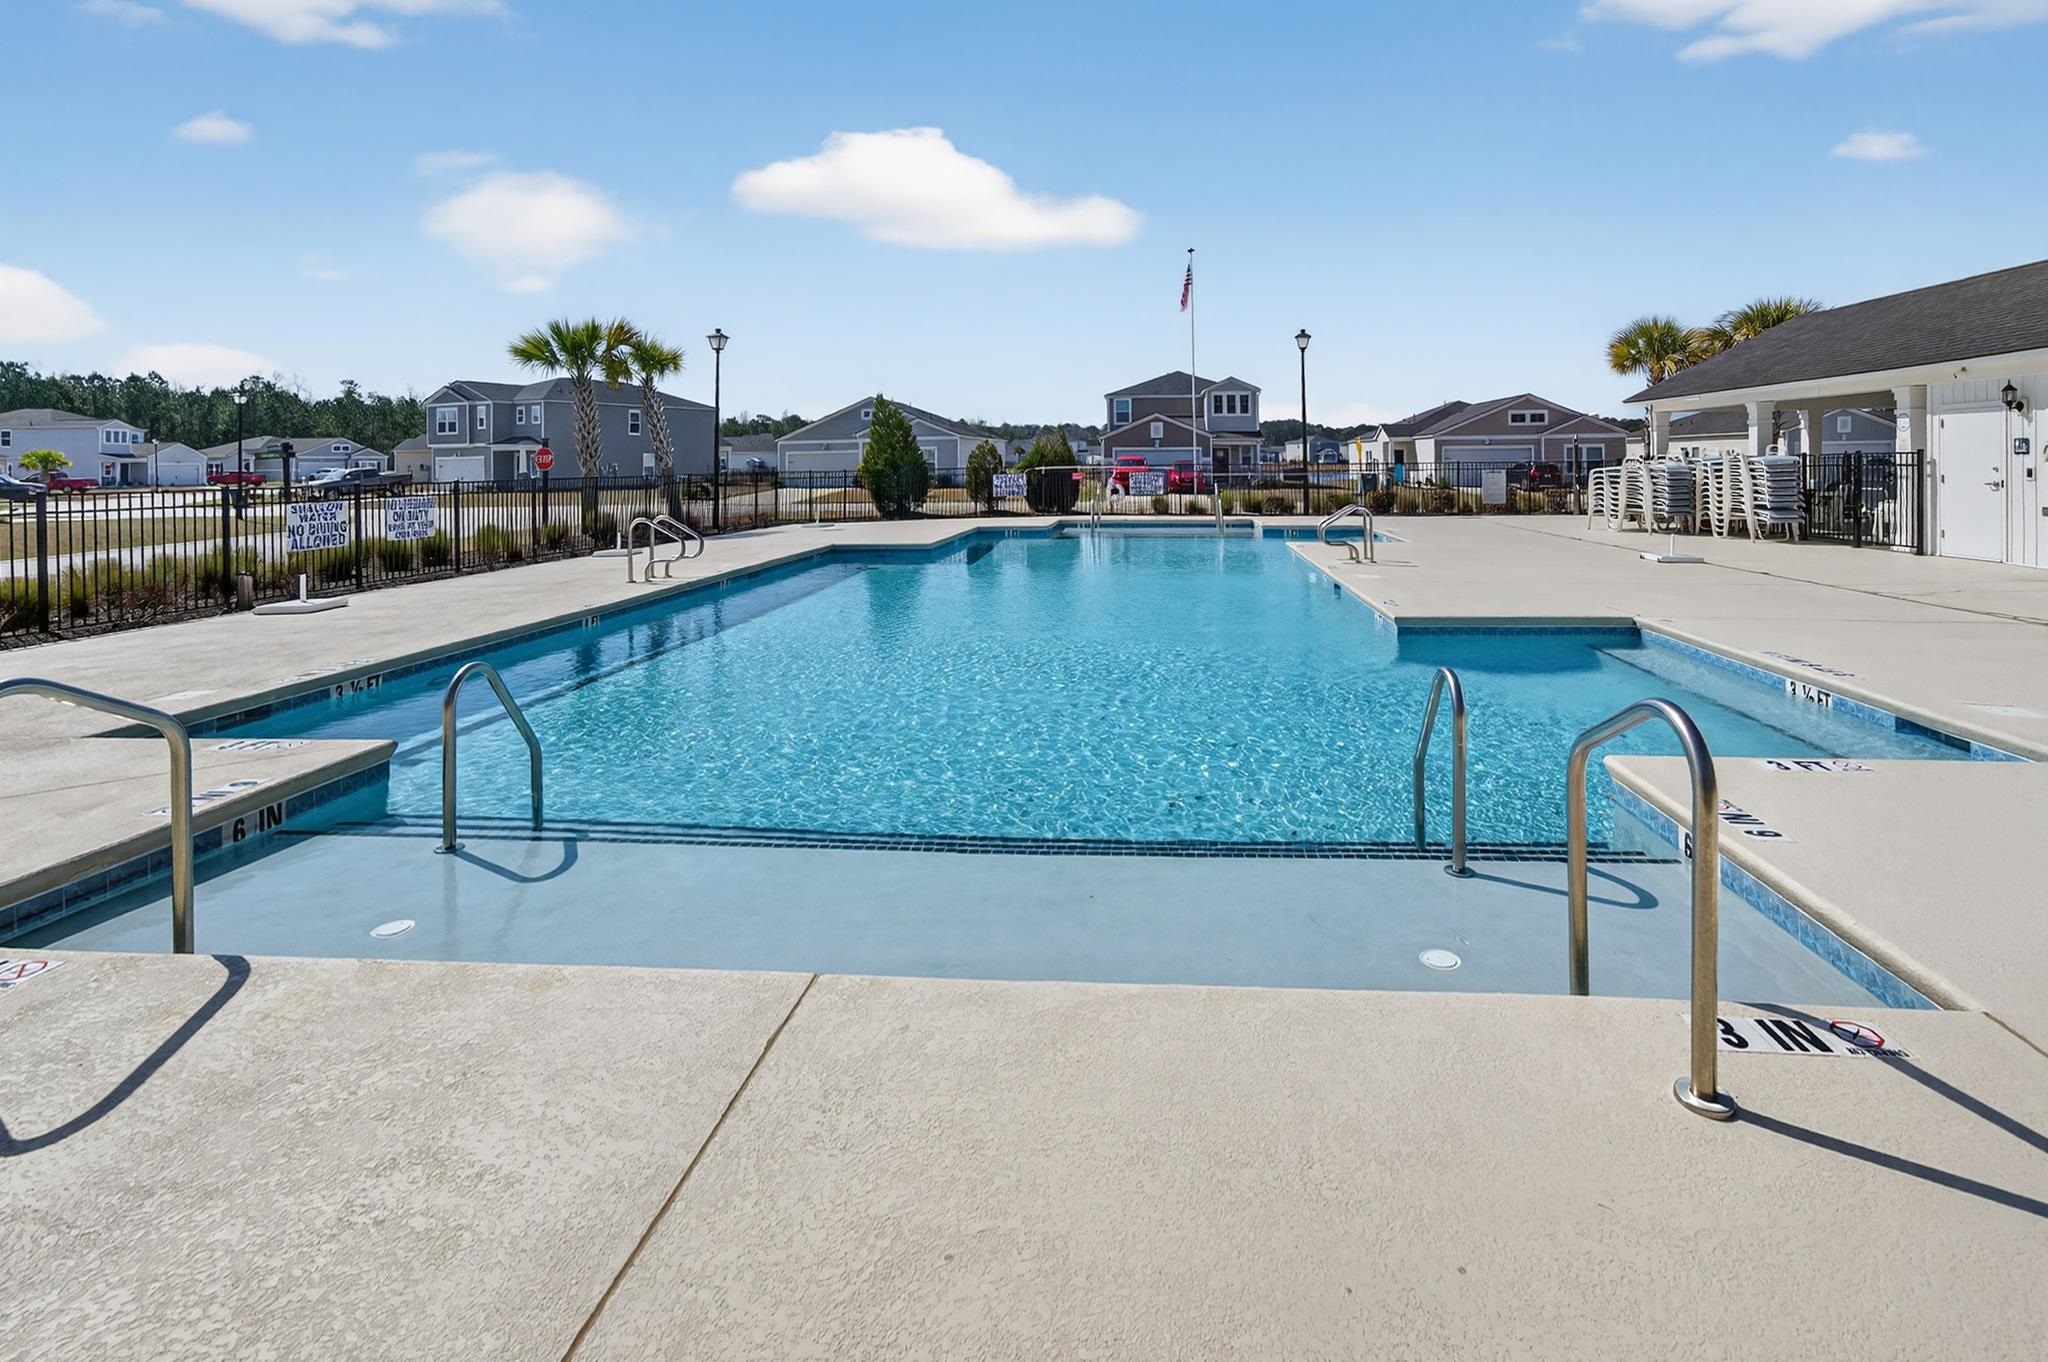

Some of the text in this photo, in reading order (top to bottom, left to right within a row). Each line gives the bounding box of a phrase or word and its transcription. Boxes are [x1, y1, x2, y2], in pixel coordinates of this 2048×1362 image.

[287, 524, 304, 538] NO
[232, 802, 283, 843] 6 IN
[1717, 1018, 1834, 1053] 3 IN
